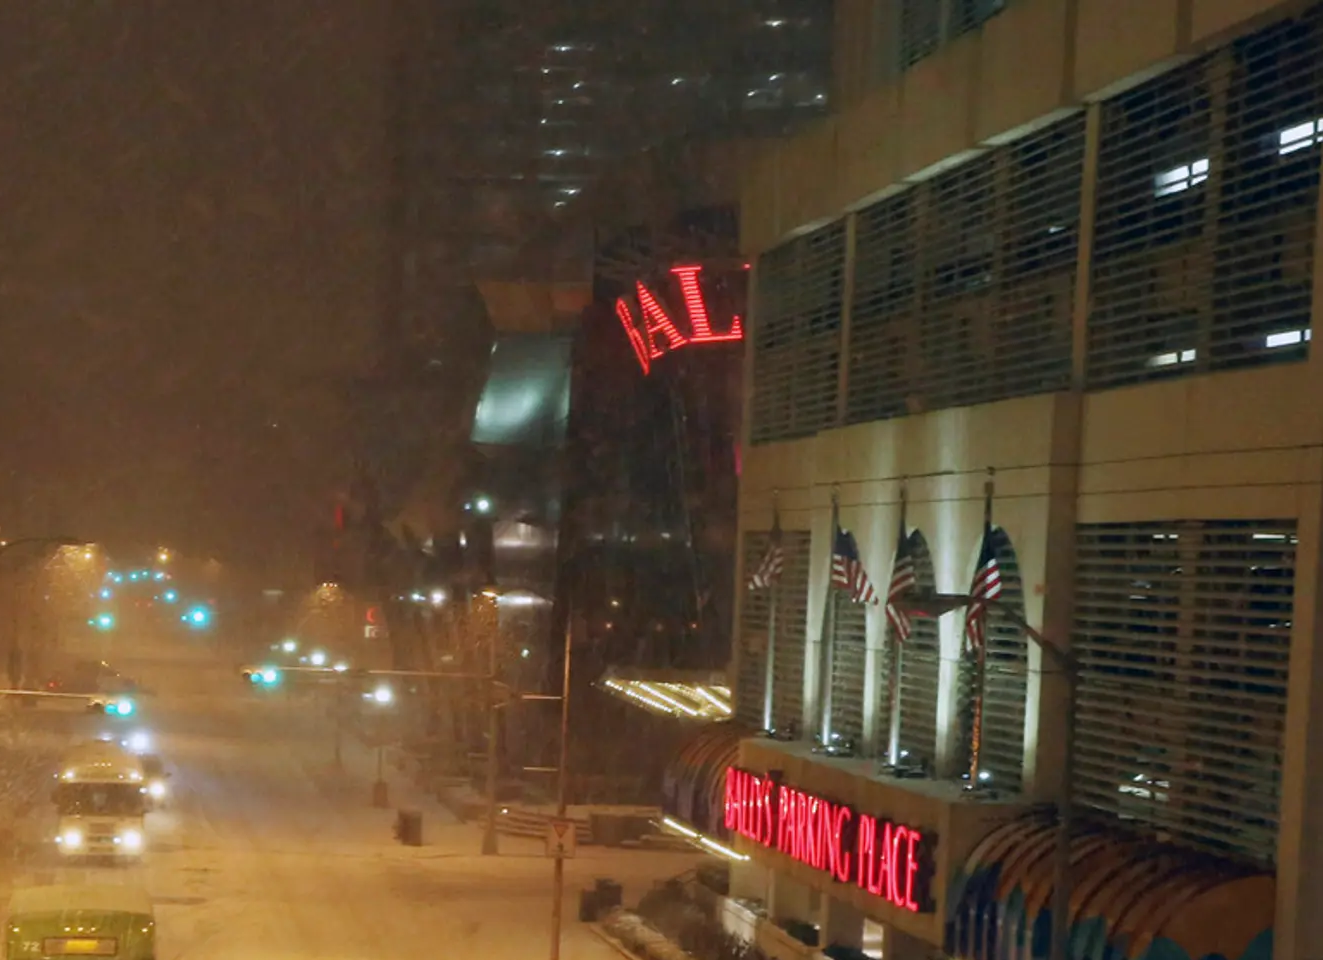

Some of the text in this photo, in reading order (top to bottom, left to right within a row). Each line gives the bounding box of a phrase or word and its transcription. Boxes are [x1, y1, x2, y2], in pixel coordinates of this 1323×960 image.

[616, 264, 744, 376] BAL
[778, 785, 851, 883] PARKING
[858, 814, 922, 912] PLACE
